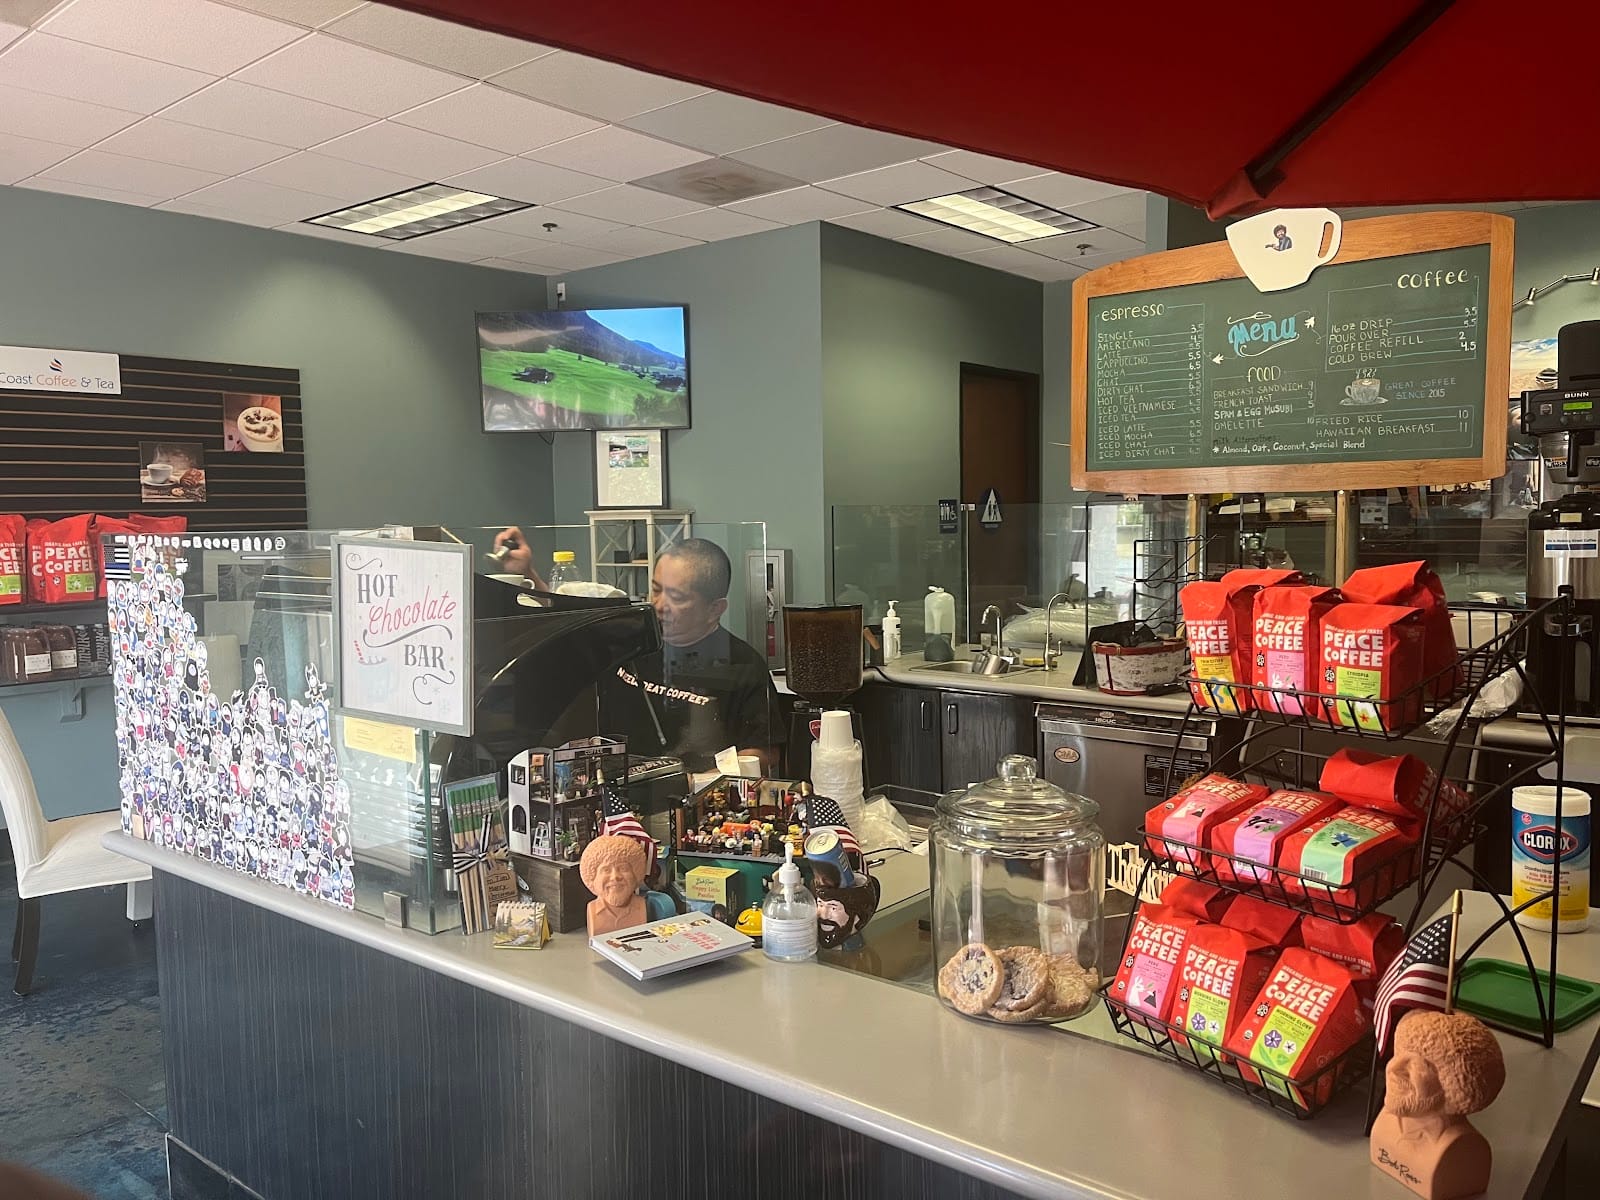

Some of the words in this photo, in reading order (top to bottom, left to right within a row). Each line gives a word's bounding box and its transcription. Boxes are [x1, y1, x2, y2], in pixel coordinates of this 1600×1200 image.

[1398, 270, 1470, 289] coffee
[1102, 304, 1164, 321] espresso
[1360, 318, 1393, 331] DRIP
[1464, 306, 1478, 317] 3.5
[1098, 331, 1134, 342] SINGLE
[1228, 316, 1297, 349] Menu
[1329, 333, 1356, 345] POUR
[1360, 329, 1389, 340] OVER
[1098, 338, 1150, 350] AMERICANO
[1330, 340, 1373, 354] COFFEE
[1380, 336, 1424, 348] REFILL
[1459, 332, 1466, 340] 2
[1097, 356, 1148, 369] CAPPUCCINO
[1188, 351, 1201, 360] 5.5
[1098, 351, 1121, 360] LATTE
[1329, 354, 1355, 365] COLD
[1361, 350, 1392, 361] BREW
[1461, 341, 1476, 351] 4.5
[1098, 368, 1126, 378] MOCHA
[1190, 361, 1201, 370] 6.5
[36, 374, 77, 387] Coffee
[80, 376, 91, 388] &
[94, 377, 114, 389] Tea
[1097, 378, 1119, 387] CHAI
[1214, 387, 1254, 399] BREAKFAST
[1257, 382, 1303, 394] SANDWICH
[1308, 380, 1314, 390] 9
[1421, 378, 1457, 388] COFFEE
[1098, 387, 1121, 397] DIRTY
[1124, 384, 1144, 394] CHAI
[1396, 392, 1425, 400] SINCE
[1428, 388, 1446, 398] 2015
[1564, 391, 1589, 399] BUNN
[1098, 397, 1113, 406] HOT
[1120, 394, 1135, 405] TEA
[1214, 399, 1245, 408] FRENCH
[1249, 394, 1273, 406] TOAST
[1098, 406, 1119, 415] ICED
[1214, 410, 1235, 420] SPAM
[1244, 407, 1261, 417] EGG
[1264, 404, 1293, 415] MUSUBI
[1308, 400, 1314, 408] 5
[1316, 416, 1350, 426] FRIED
[1358, 414, 1383, 423] RICE
[1458, 410, 1469, 419] 10
[1098, 415, 1119, 424] ICED
[1122, 414, 1136, 422] TEA
[1214, 418, 1265, 430] OMELETTE
[1099, 426, 1119, 434] ICED
[1124, 423, 1146, 433] LATTE
[1124, 432, 1153, 441] MOCHA
[1316, 426, 1371, 438] HAWAIIAN
[1378, 424, 1435, 436] BREAKFAST
[1125, 441, 1146, 449] CHAI
[1343, 438, 1365, 449] Blend
[1099, 451, 1120, 459] ICED
[1126, 449, 1150, 458] DIRTY
[1154, 446, 1175, 456] CHAI
[358, 573, 398, 604] HOT
[368, 586, 457, 635] Chocolate
[1255, 618, 1304, 636] PEACE
[1255, 634, 1304, 651] COFFEE
[1324, 630, 1384, 650] PEACE
[404, 644, 446, 671] BAR
[1324, 648, 1383, 667] COFFEE
[666, 687, 710, 706] COFFEE?
[1135, 921, 1185, 949] PEACE
[1130, 936, 1180, 965] COFFEE
[1186, 950, 1237, 981] PEACE
[1183, 966, 1233, 998] COFFEE
[1273, 970, 1334, 1008] PEACE
[1265, 984, 1324, 1022] COFFEE
